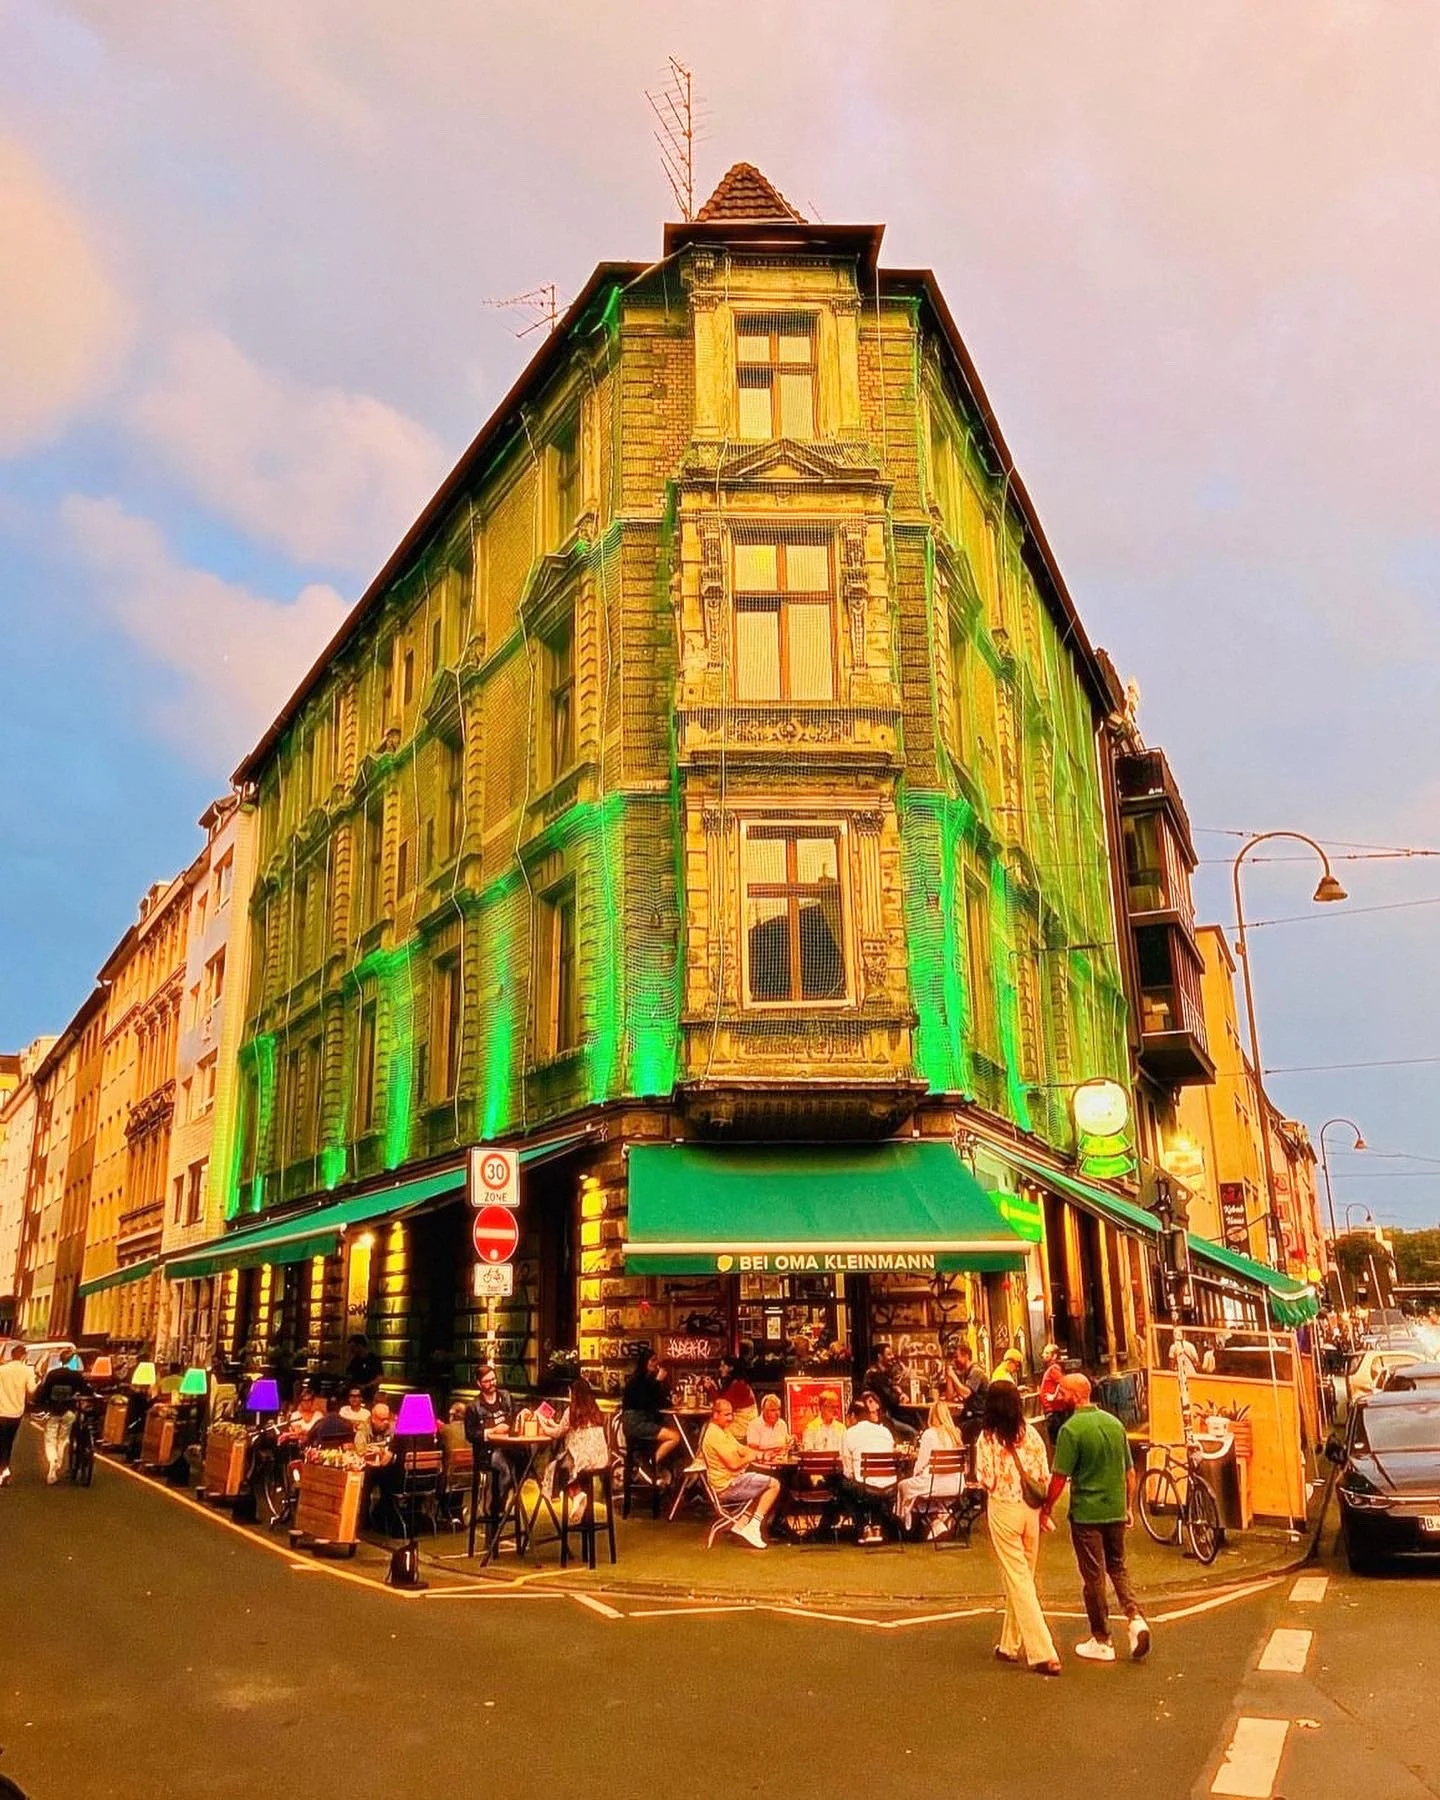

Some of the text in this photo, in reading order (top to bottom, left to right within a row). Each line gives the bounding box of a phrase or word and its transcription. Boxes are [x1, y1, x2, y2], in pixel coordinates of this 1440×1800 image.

[487, 1163, 505, 1181] 30
[484, 1192, 508, 1202] ZONE
[739, 1254, 935, 1271] BEI OMA KLEINMANN
